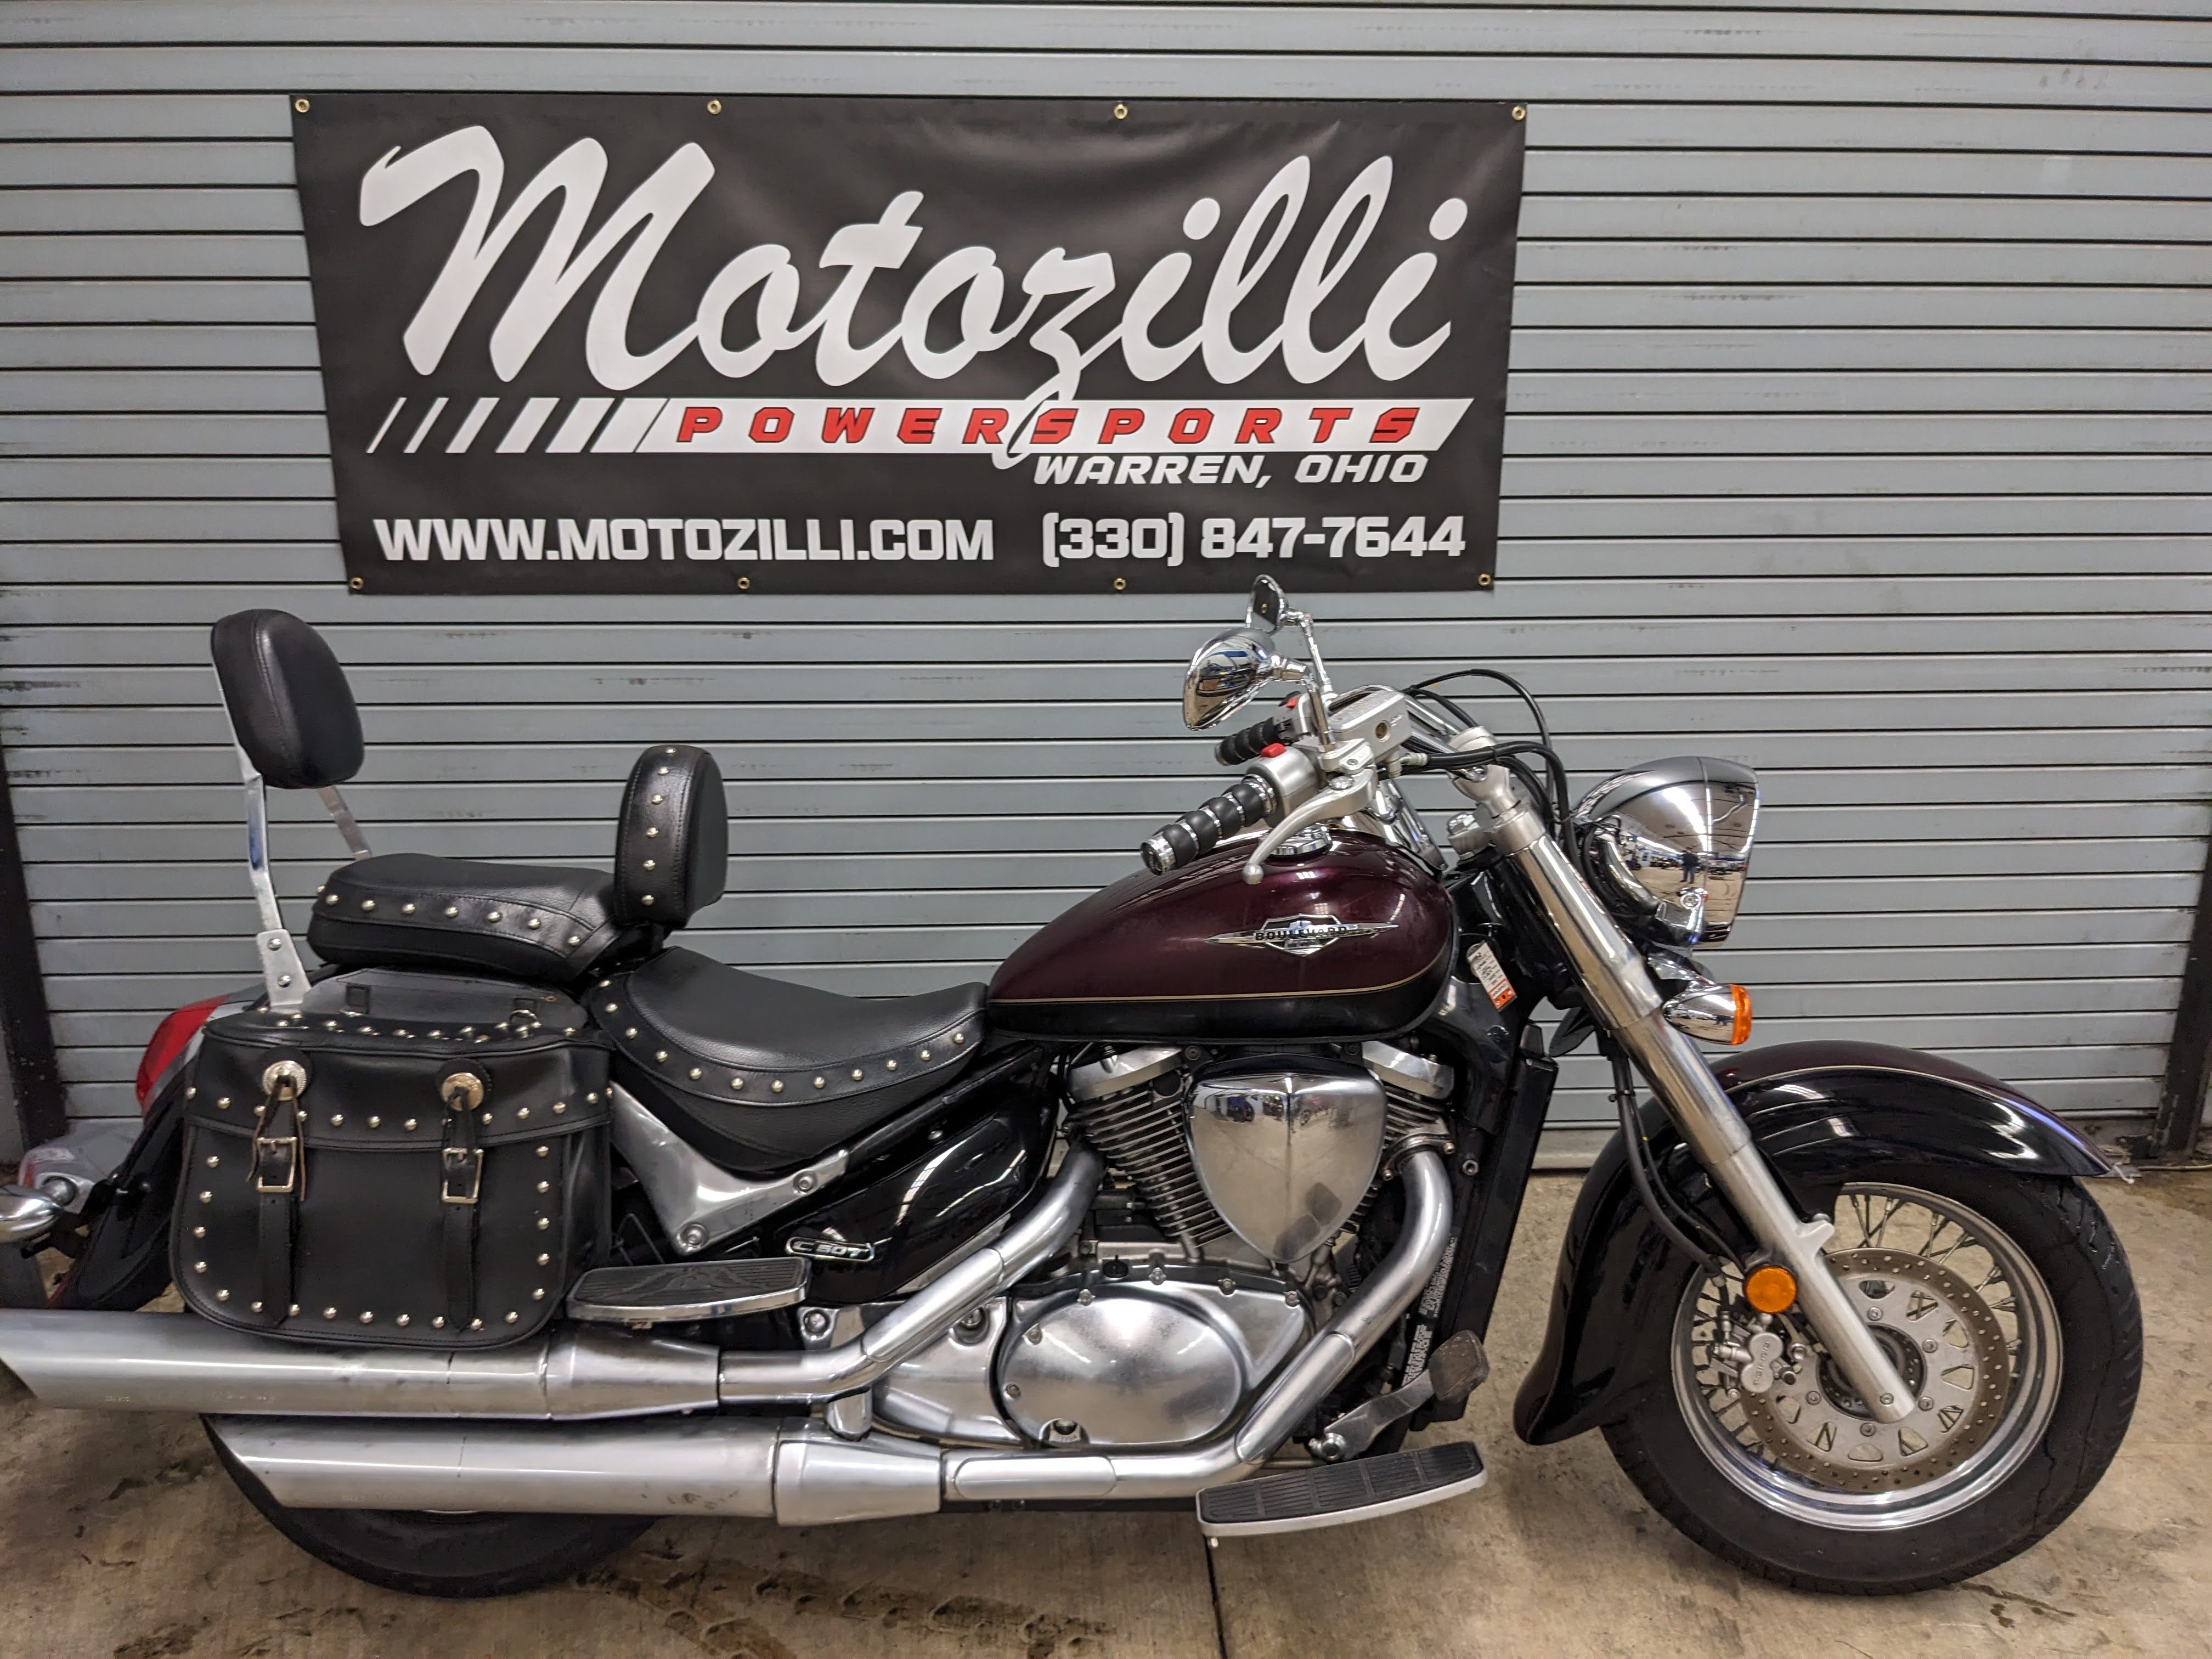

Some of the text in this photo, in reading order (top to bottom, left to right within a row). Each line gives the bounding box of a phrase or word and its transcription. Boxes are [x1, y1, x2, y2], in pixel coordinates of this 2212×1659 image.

[359, 126, 1468, 468] Motozilli
[676, 407, 1420, 444] POWERSPORTS
[1033, 454, 1429, 488] WARREN, OHIO
[373, 511, 1466, 567] WWW.MOTOZILLI.COM (330) 847-7644
